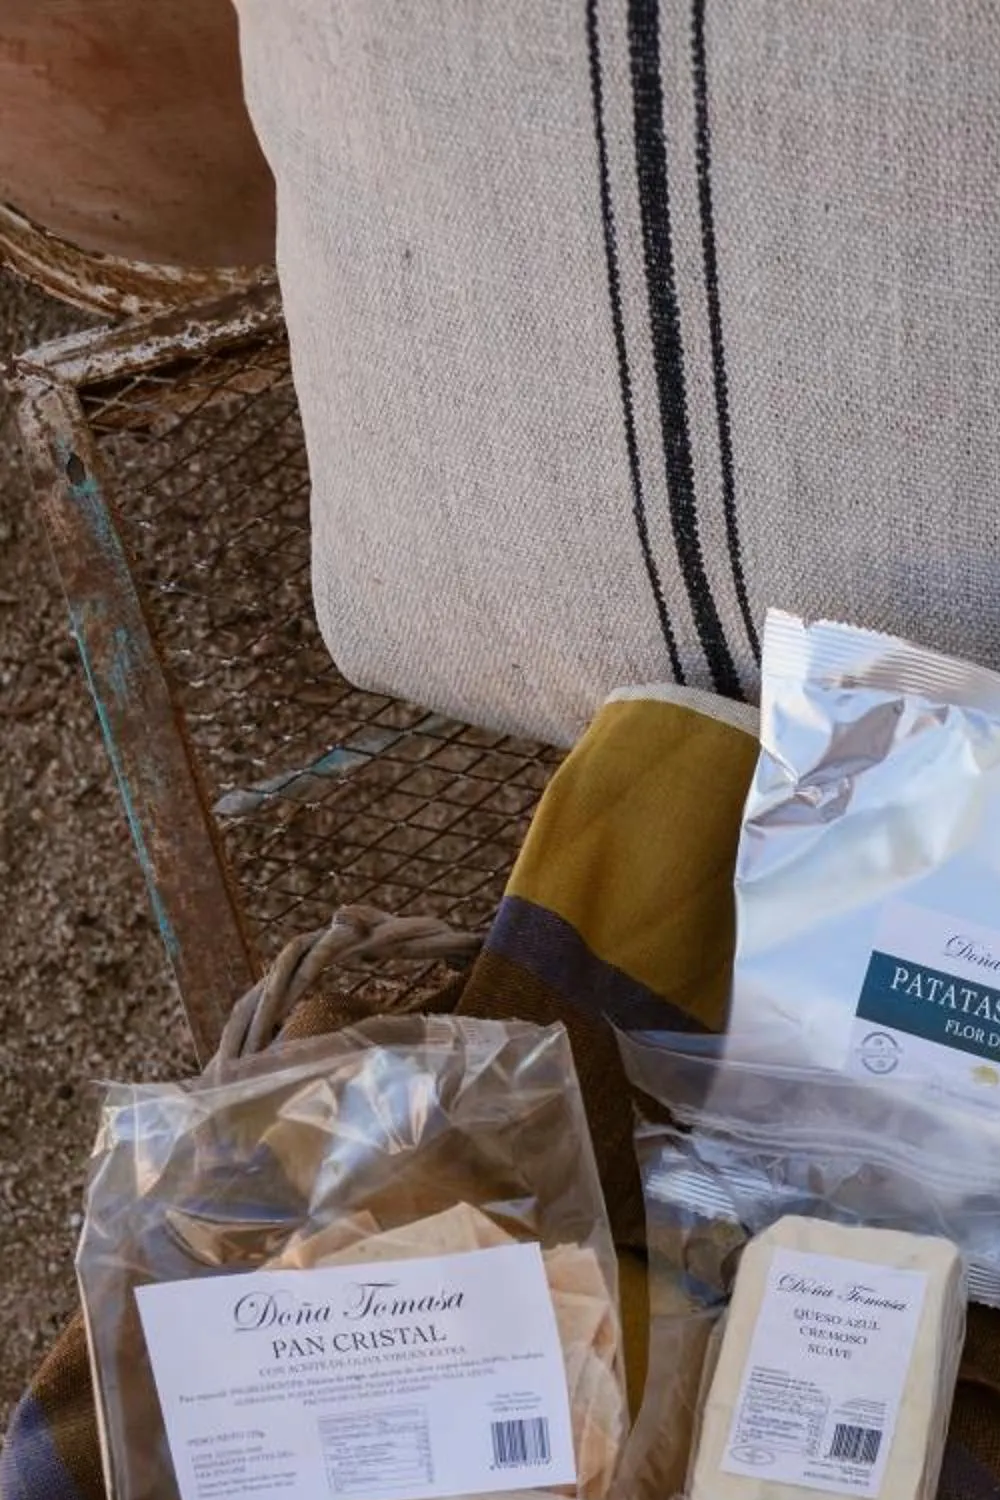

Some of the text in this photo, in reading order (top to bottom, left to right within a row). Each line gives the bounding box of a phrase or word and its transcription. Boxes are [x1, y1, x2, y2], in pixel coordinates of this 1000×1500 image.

[943, 935, 1000, 971] Doña
[944, 1018, 985, 1043] FLOR
[233, 1282, 464, 1331] Doña Tomasa
[837, 1284, 906, 1311] Tomasa
[793, 1307, 880, 1331] QUESO AZUL
[271, 1324, 446, 1359] PAN CRISTAL
[798, 1326, 868, 1345] CREMOSO
[807, 1343, 851, 1359] SUAVE
